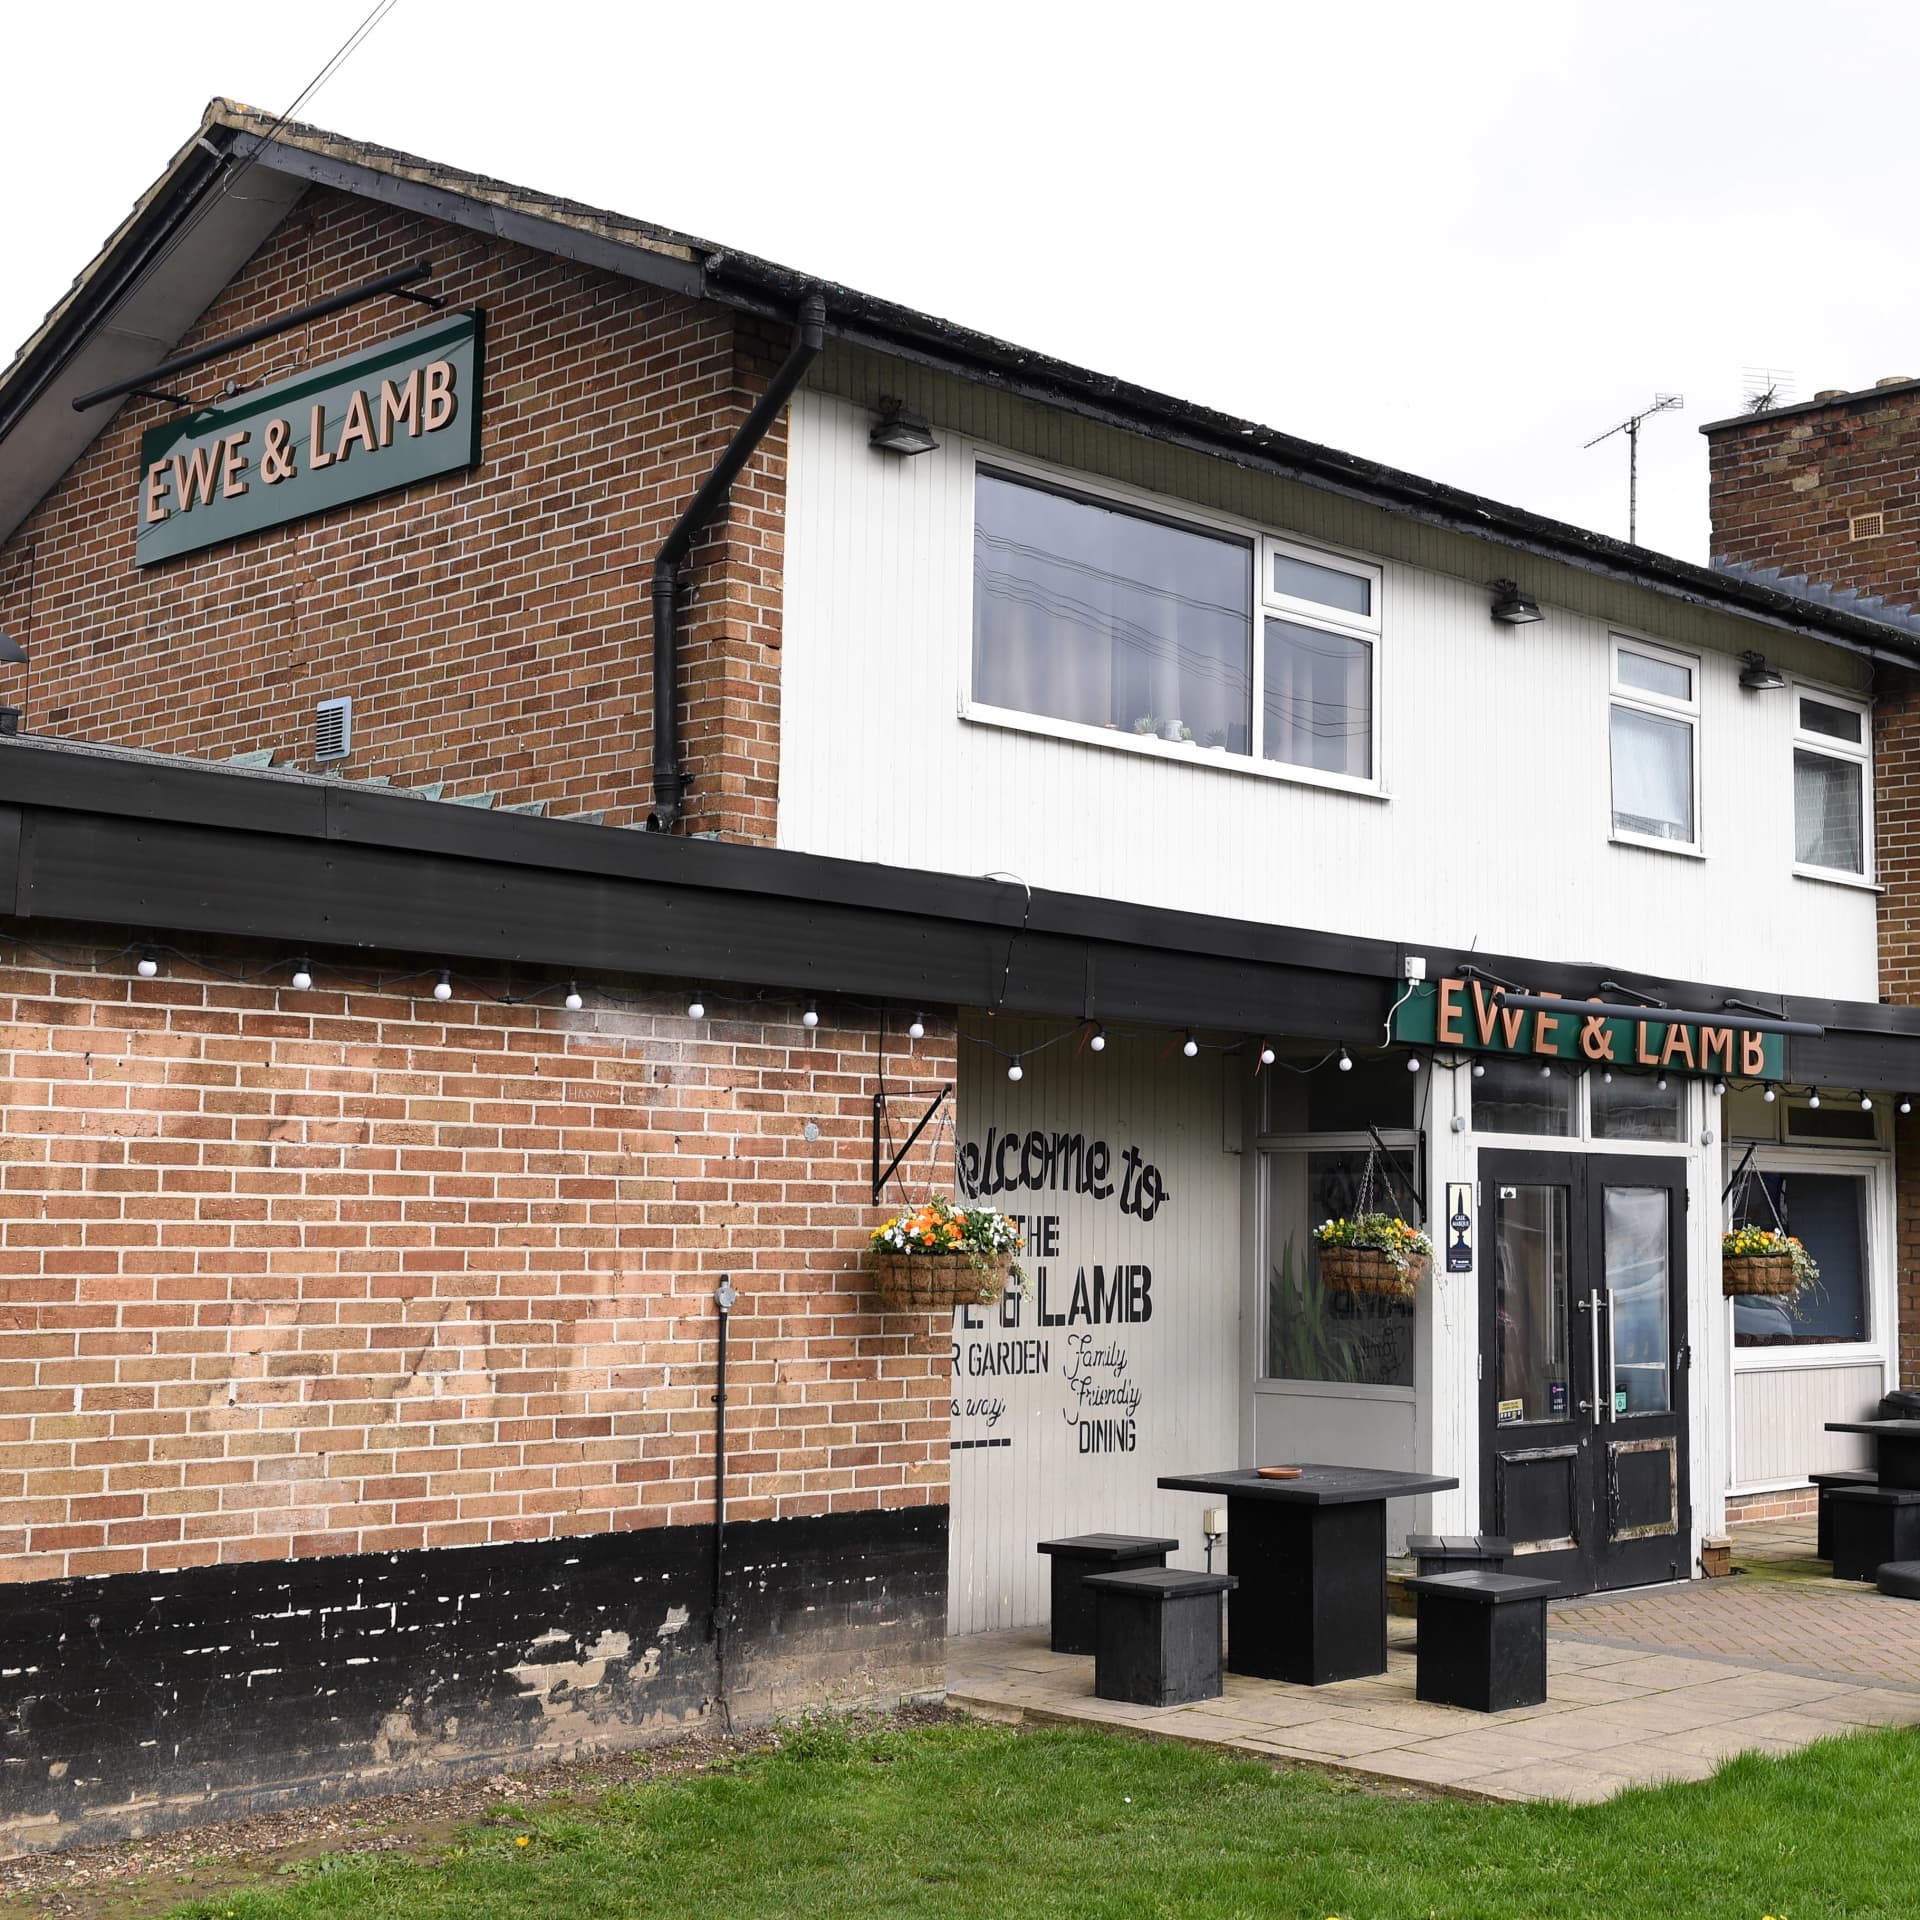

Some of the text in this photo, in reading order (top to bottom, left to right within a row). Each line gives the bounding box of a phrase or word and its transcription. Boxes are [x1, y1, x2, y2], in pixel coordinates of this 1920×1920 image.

[146, 360, 457, 523] EWE & LAMB
[1438, 977, 1765, 1076] EWE & LAMB
[956, 1127, 1170, 1222] elcome to
[1037, 1265, 1153, 1327] LAMB
[968, 1340, 1049, 1376] GARDEN
[1063, 1333, 1128, 1380] Family
[1063, 1376, 1142, 1426] Friendly
[1079, 1418, 1136, 1454] DINING
